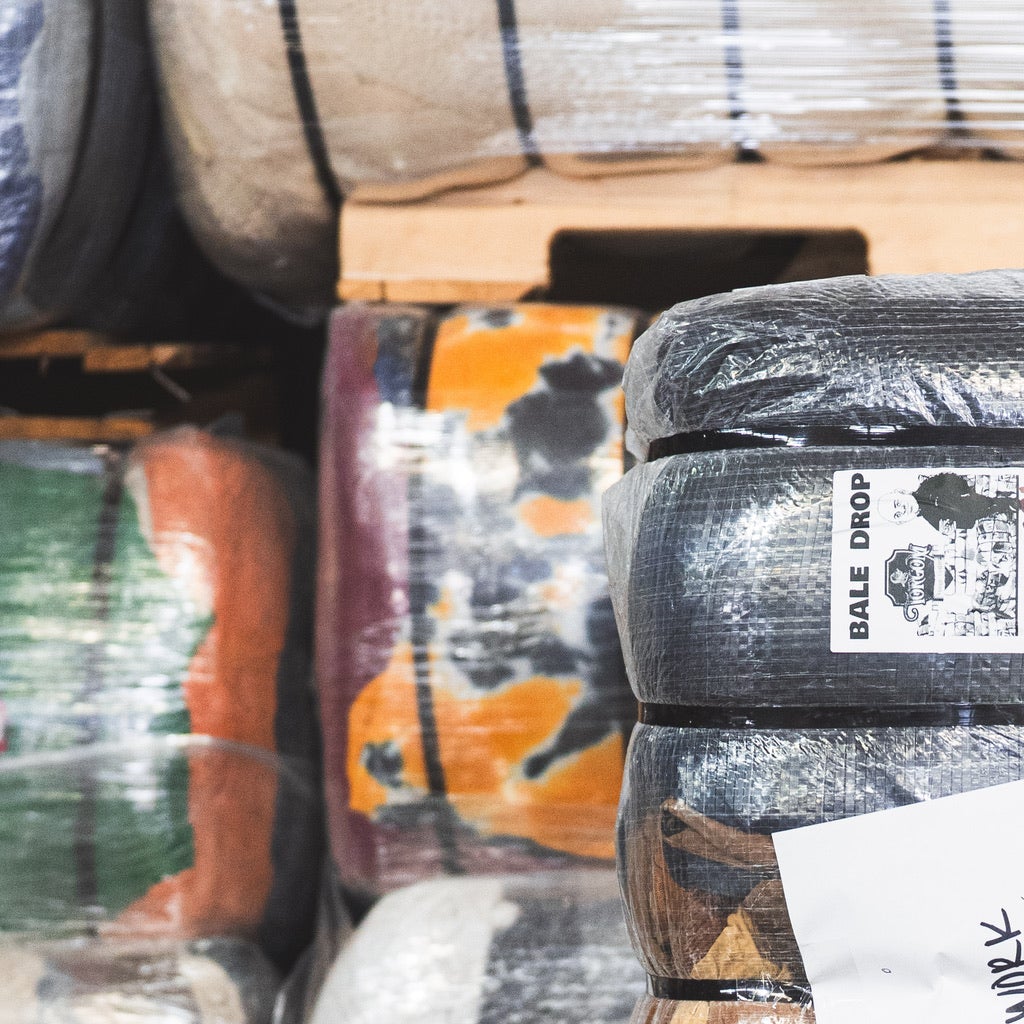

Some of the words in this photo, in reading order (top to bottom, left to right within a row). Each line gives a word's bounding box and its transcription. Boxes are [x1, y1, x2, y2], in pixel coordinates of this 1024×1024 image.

[849, 472, 871, 550] DROP
[849, 565, 870, 640] BALE
[903, 542, 933, 622] TORGOM
